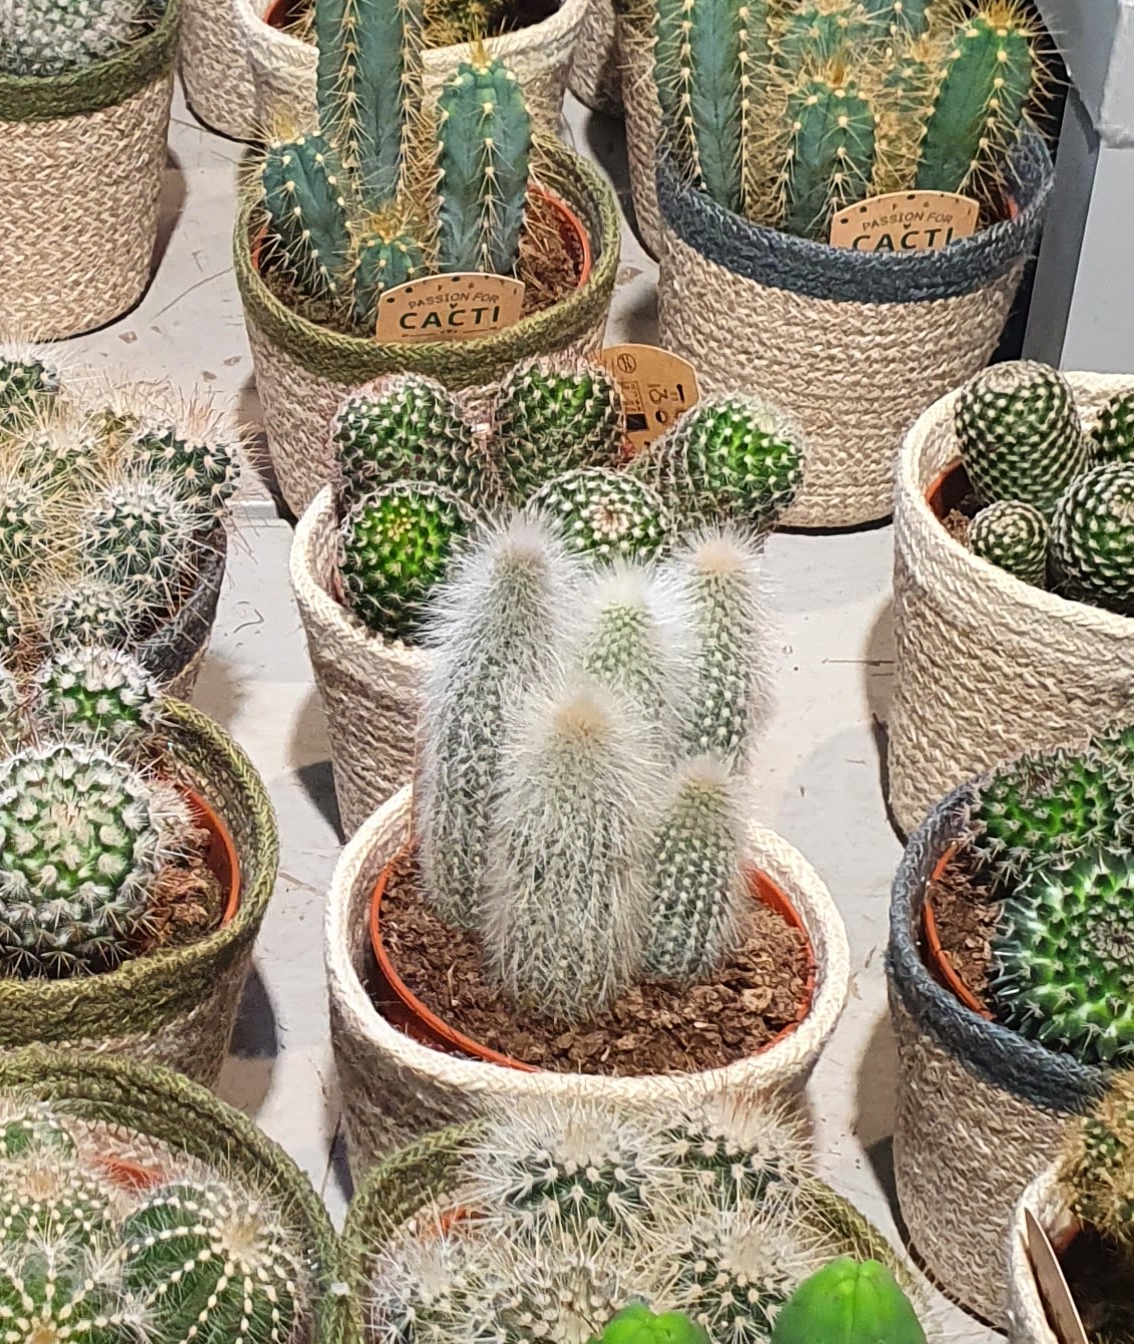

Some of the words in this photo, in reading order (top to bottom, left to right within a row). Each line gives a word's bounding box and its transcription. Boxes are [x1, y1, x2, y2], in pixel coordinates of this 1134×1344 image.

[862, 211, 924, 232] PASSION
[926, 211, 954, 224] FOR
[851, 227, 954, 252] CACTI
[408, 292, 471, 309] PASSION
[471, 293, 500, 304] FOR
[399, 305, 500, 330] CACTI
